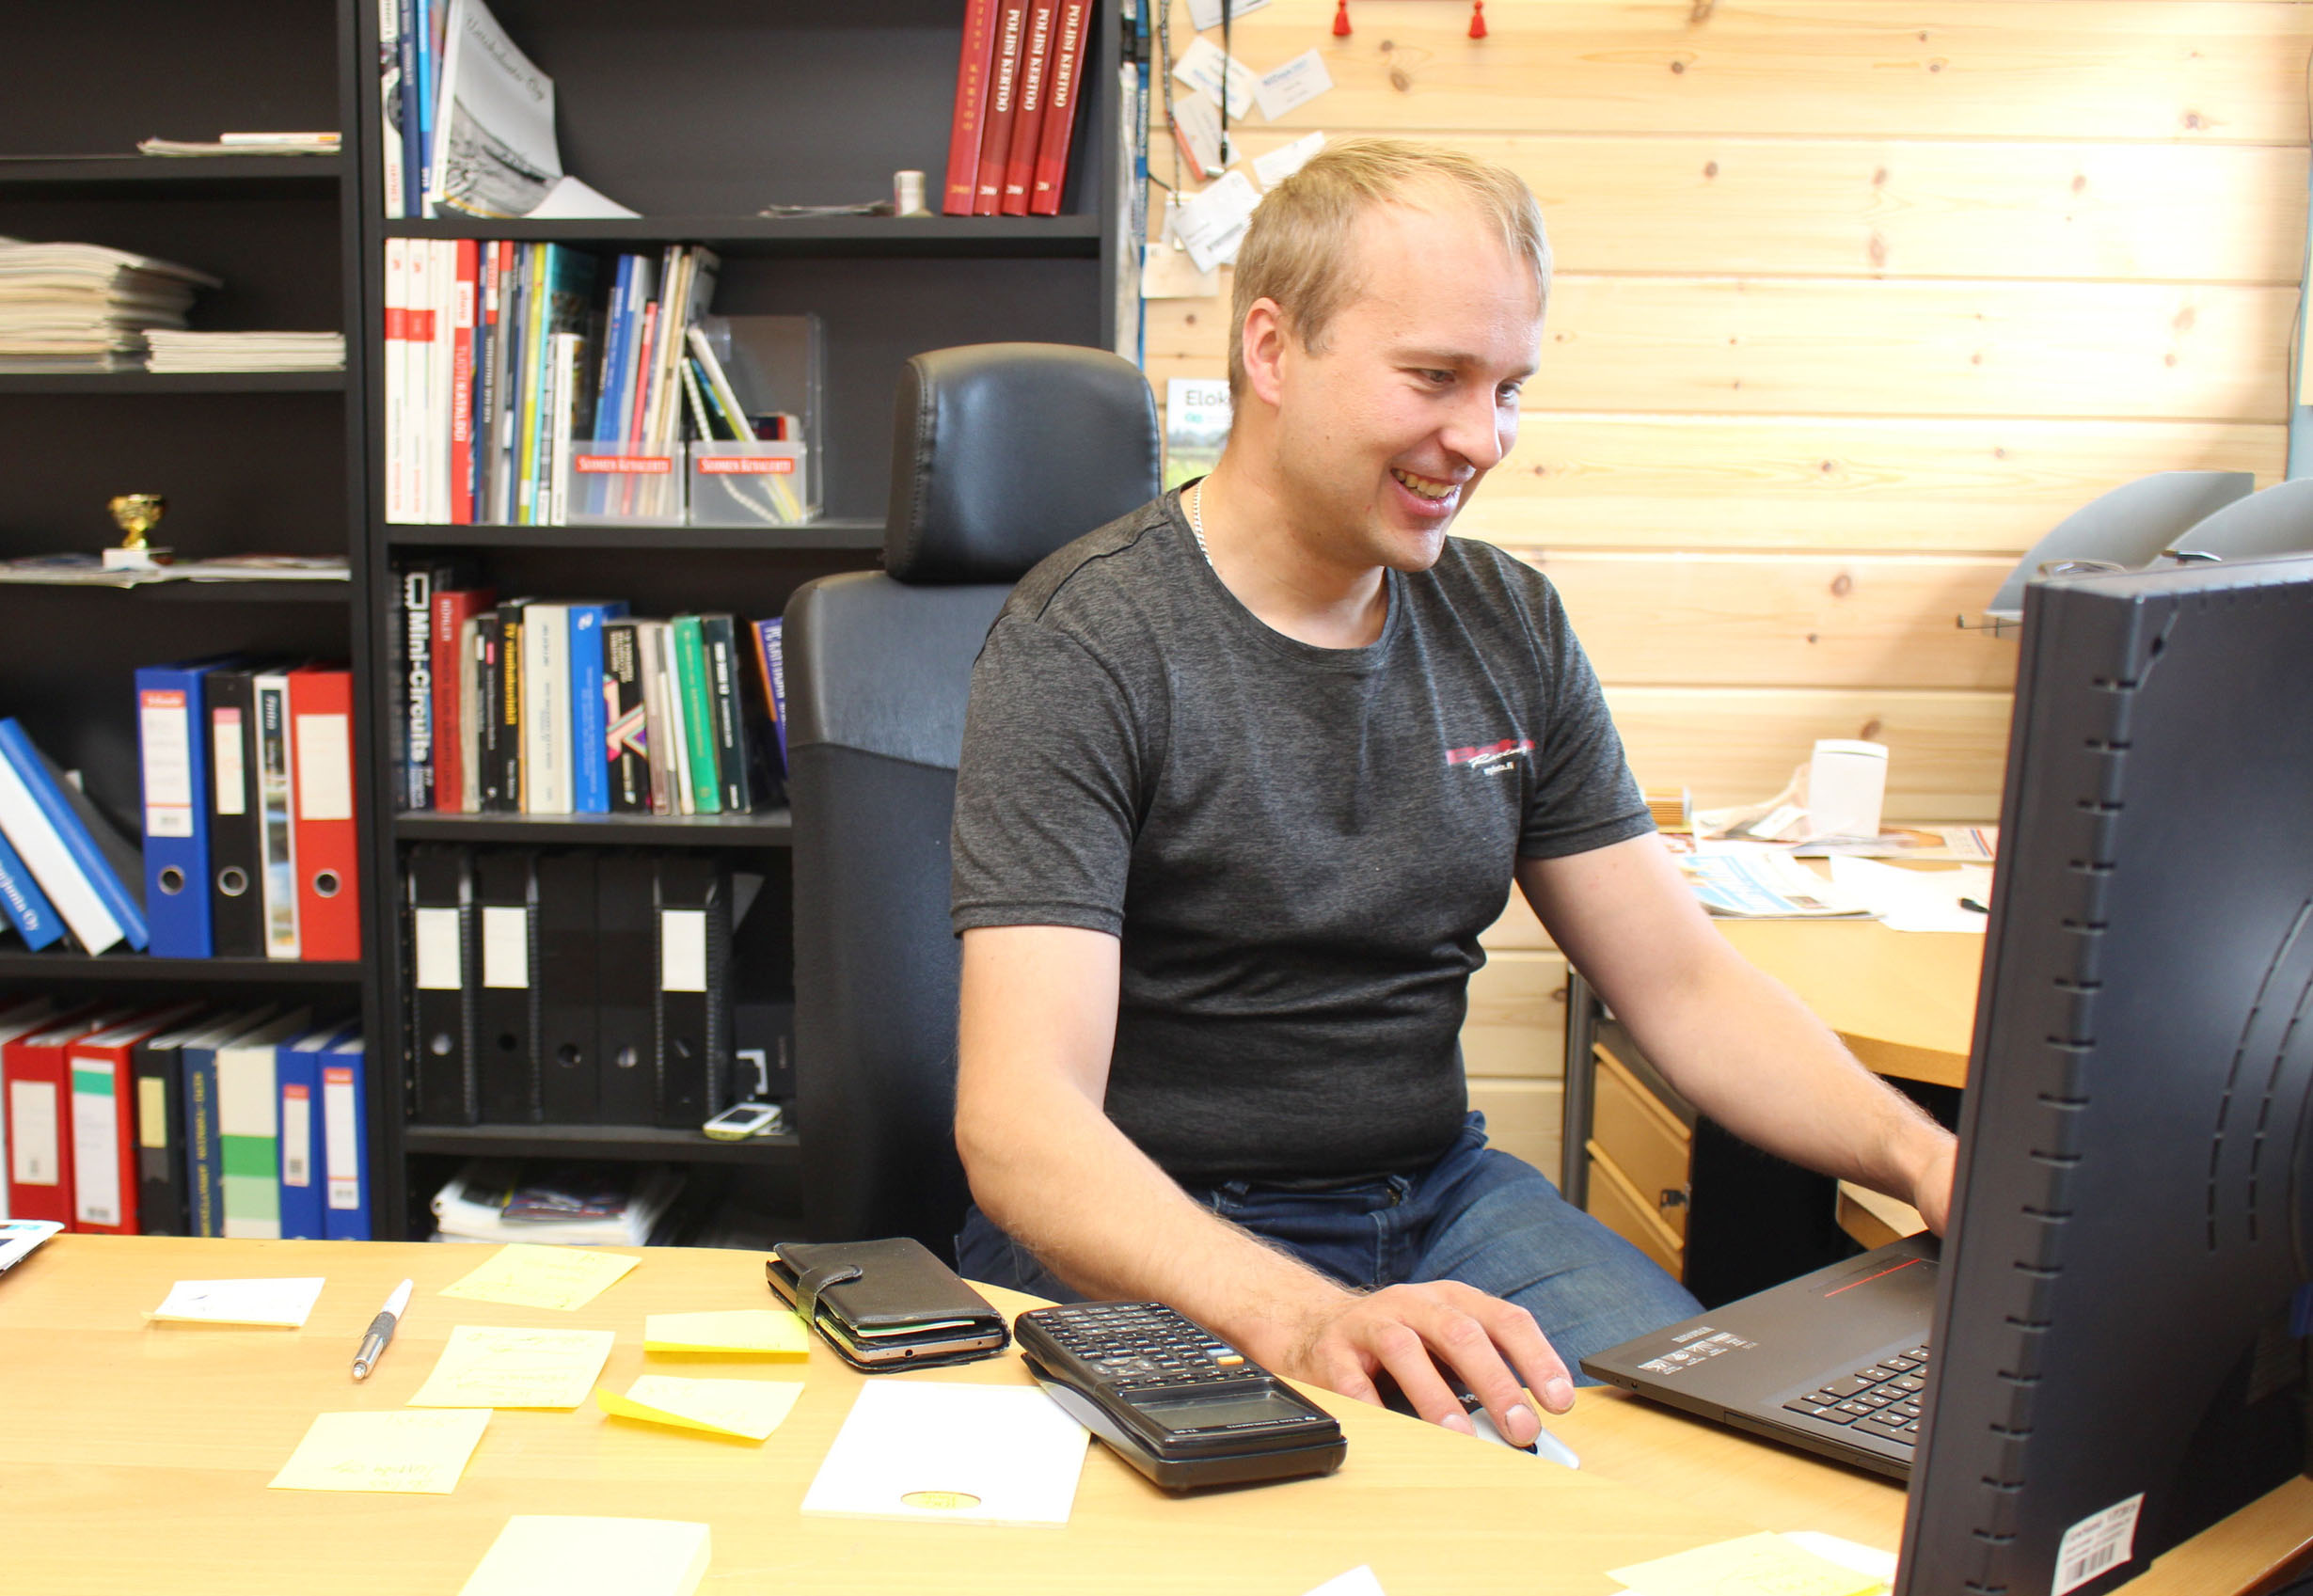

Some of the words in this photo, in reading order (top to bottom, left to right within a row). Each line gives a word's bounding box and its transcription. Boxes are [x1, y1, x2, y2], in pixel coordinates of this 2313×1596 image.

[1003, 8, 1022, 56] POLIISI
[1032, 8, 1051, 55] POLIISI
[1062, 5, 1081, 52] POLIISI
[995, 58, 1015, 112] KERTOO
[1023, 57, 1043, 111] KERTOO
[1054, 54, 1074, 108] KERTOO
[408, 611, 431, 763] Mini-Circuits
